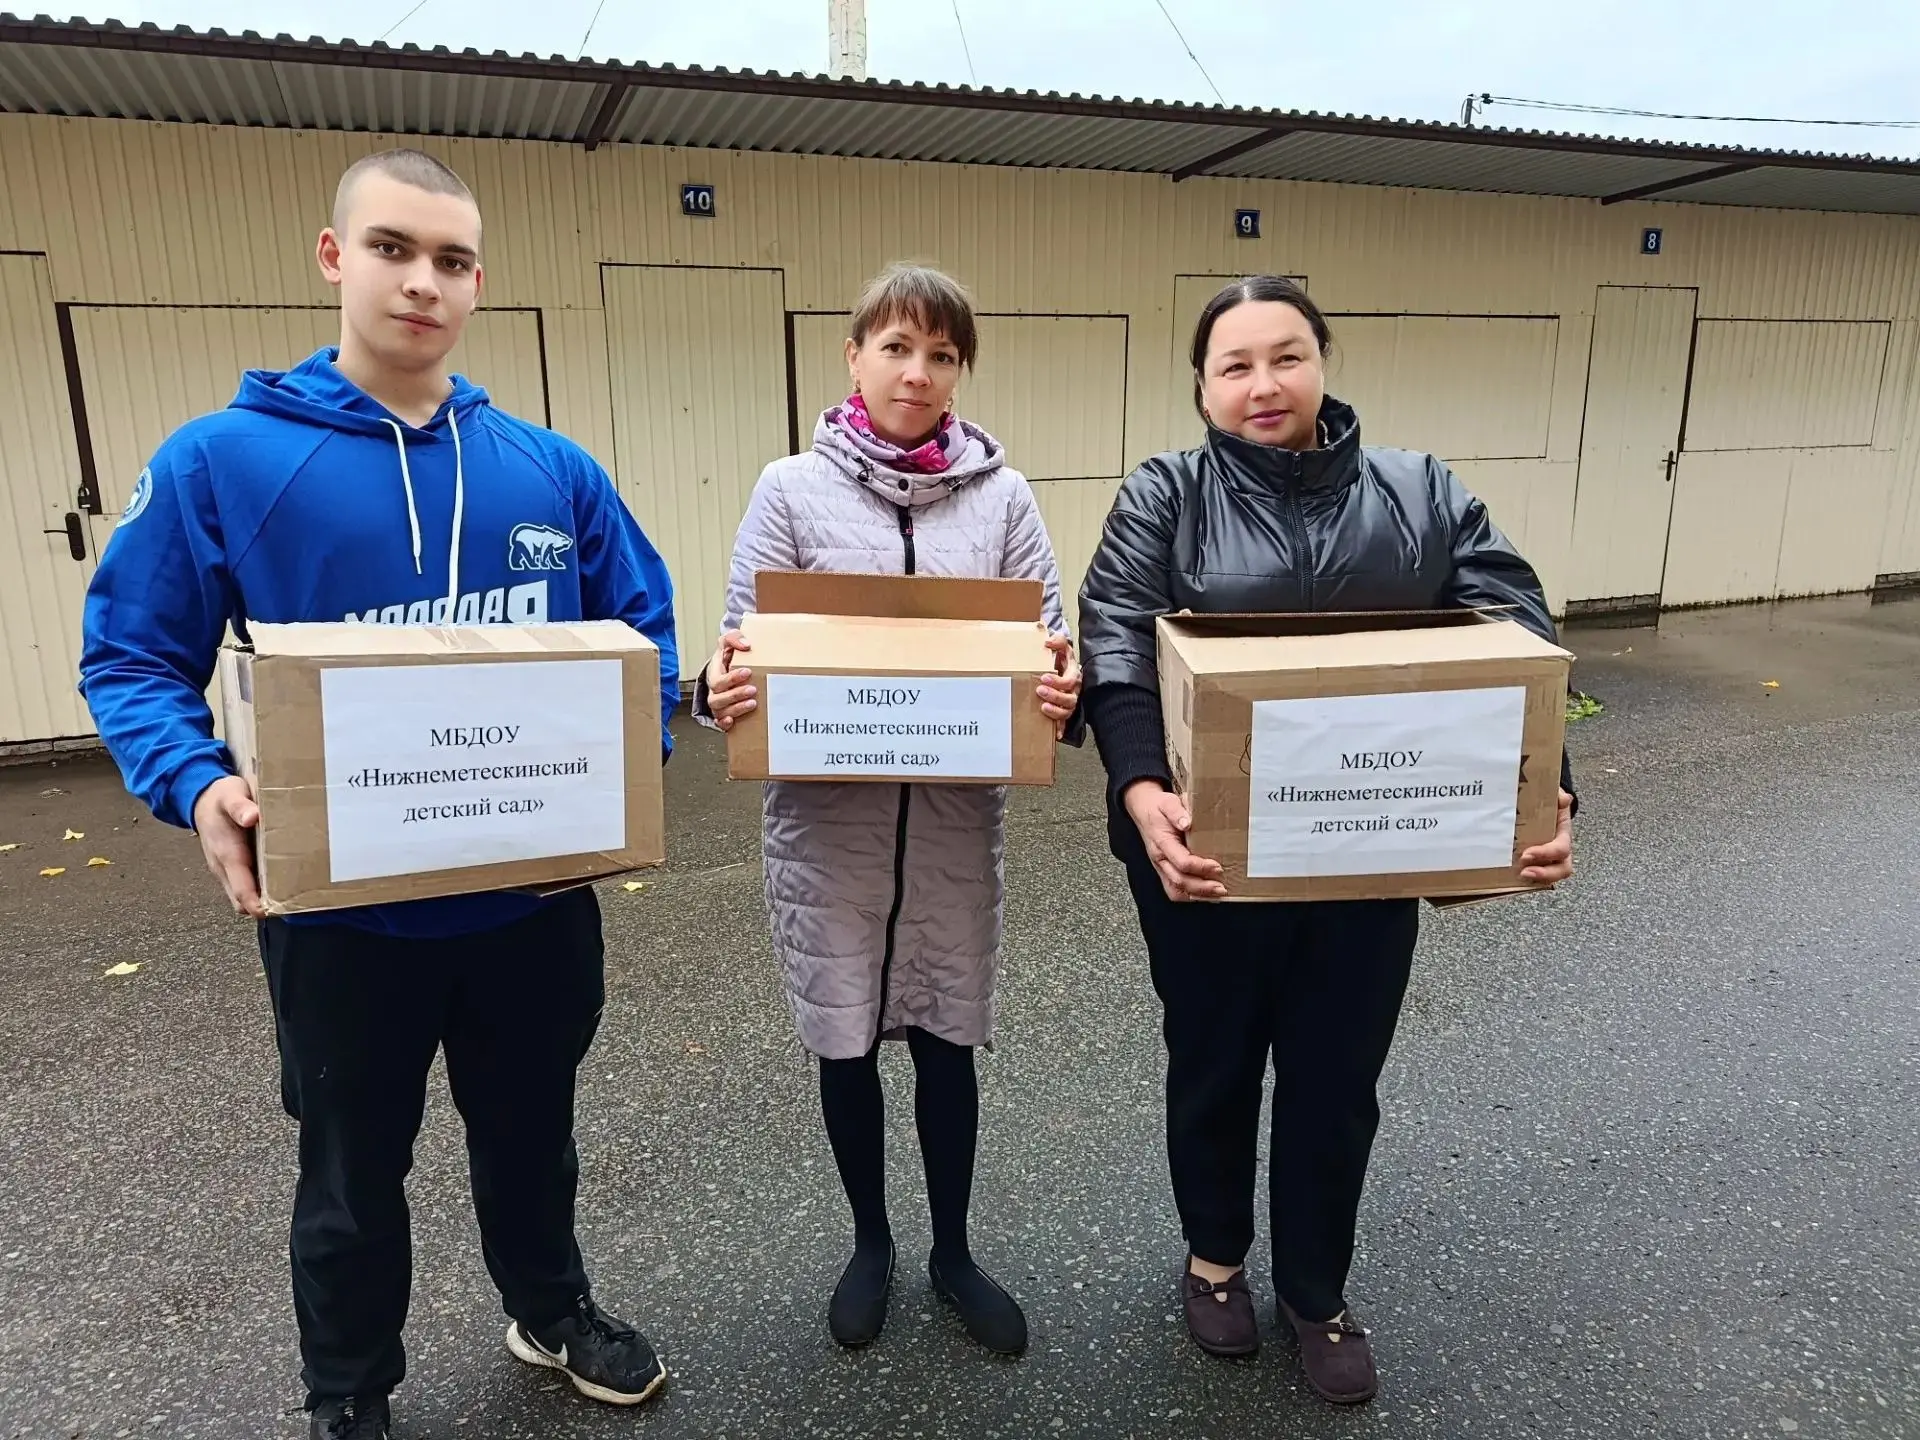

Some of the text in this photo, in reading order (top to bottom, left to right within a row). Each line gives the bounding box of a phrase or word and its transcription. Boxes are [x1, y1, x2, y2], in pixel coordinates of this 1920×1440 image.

[685, 190, 711, 210] 10
[1241, 215, 1252, 233] 9
[1647, 232, 1657, 250] 8
[848, 689, 920, 708] МБДОУ
[784, 719, 978, 736] «Нижнеметескинский
[431, 726, 520, 749] МБДОУ
[824, 750, 940, 766] детский сад»
[1340, 751, 1423, 771] МБДОУ
[348, 757, 588, 788] «Нижнеметескинский
[1266, 780, 1483, 802] «Нижнеметескинский
[403, 798, 544, 824] детский сад»
[1311, 816, 1438, 834] детский сад»
